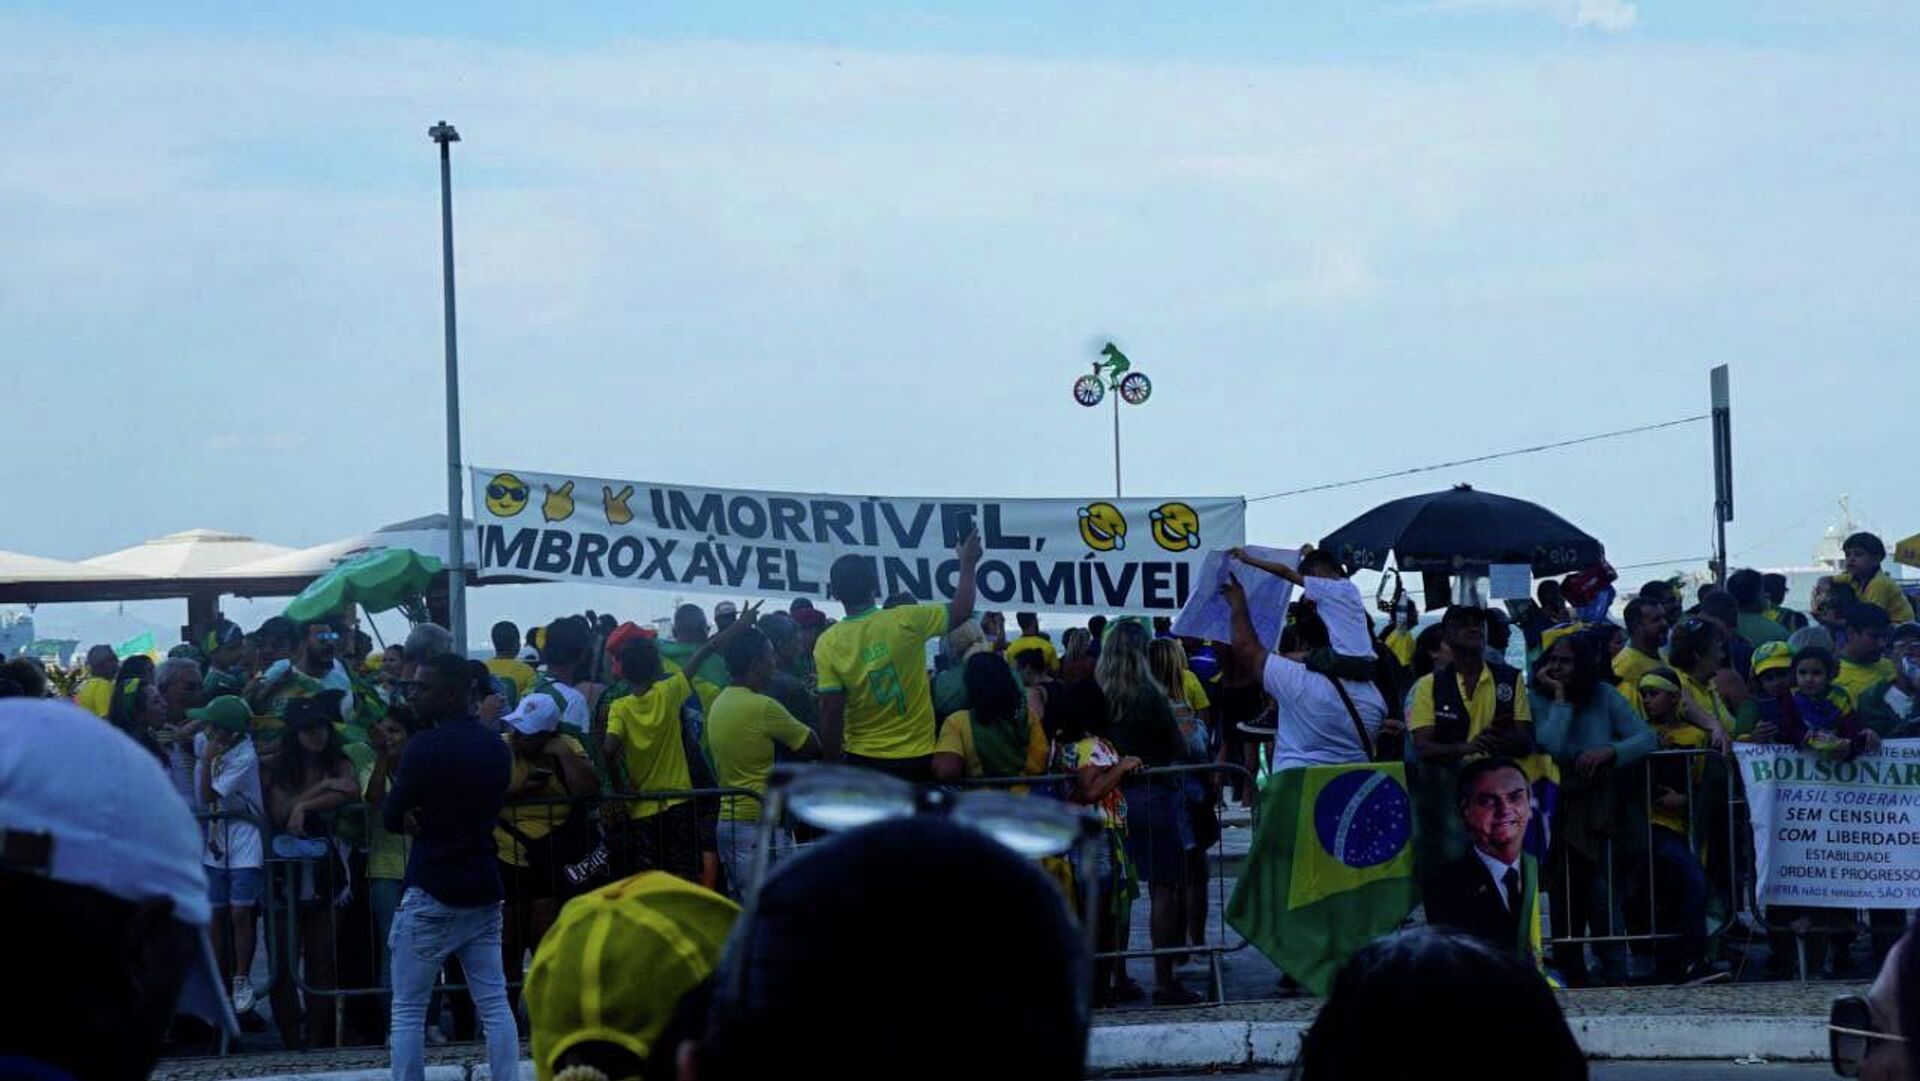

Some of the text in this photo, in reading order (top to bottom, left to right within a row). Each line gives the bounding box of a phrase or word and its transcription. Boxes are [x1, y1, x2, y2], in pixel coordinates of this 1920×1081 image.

[649, 488, 1046, 553] IMORRÍVEL,
[868, 659, 904, 719] 9
[1785, 807, 1911, 825] SEM CENSURA
[1778, 828, 1920, 846] COM LIBERDADE
[1805, 849, 1891, 864] ESTABILIDADE
[1780, 865, 1920, 882] ORDEM E PROGRESSO
